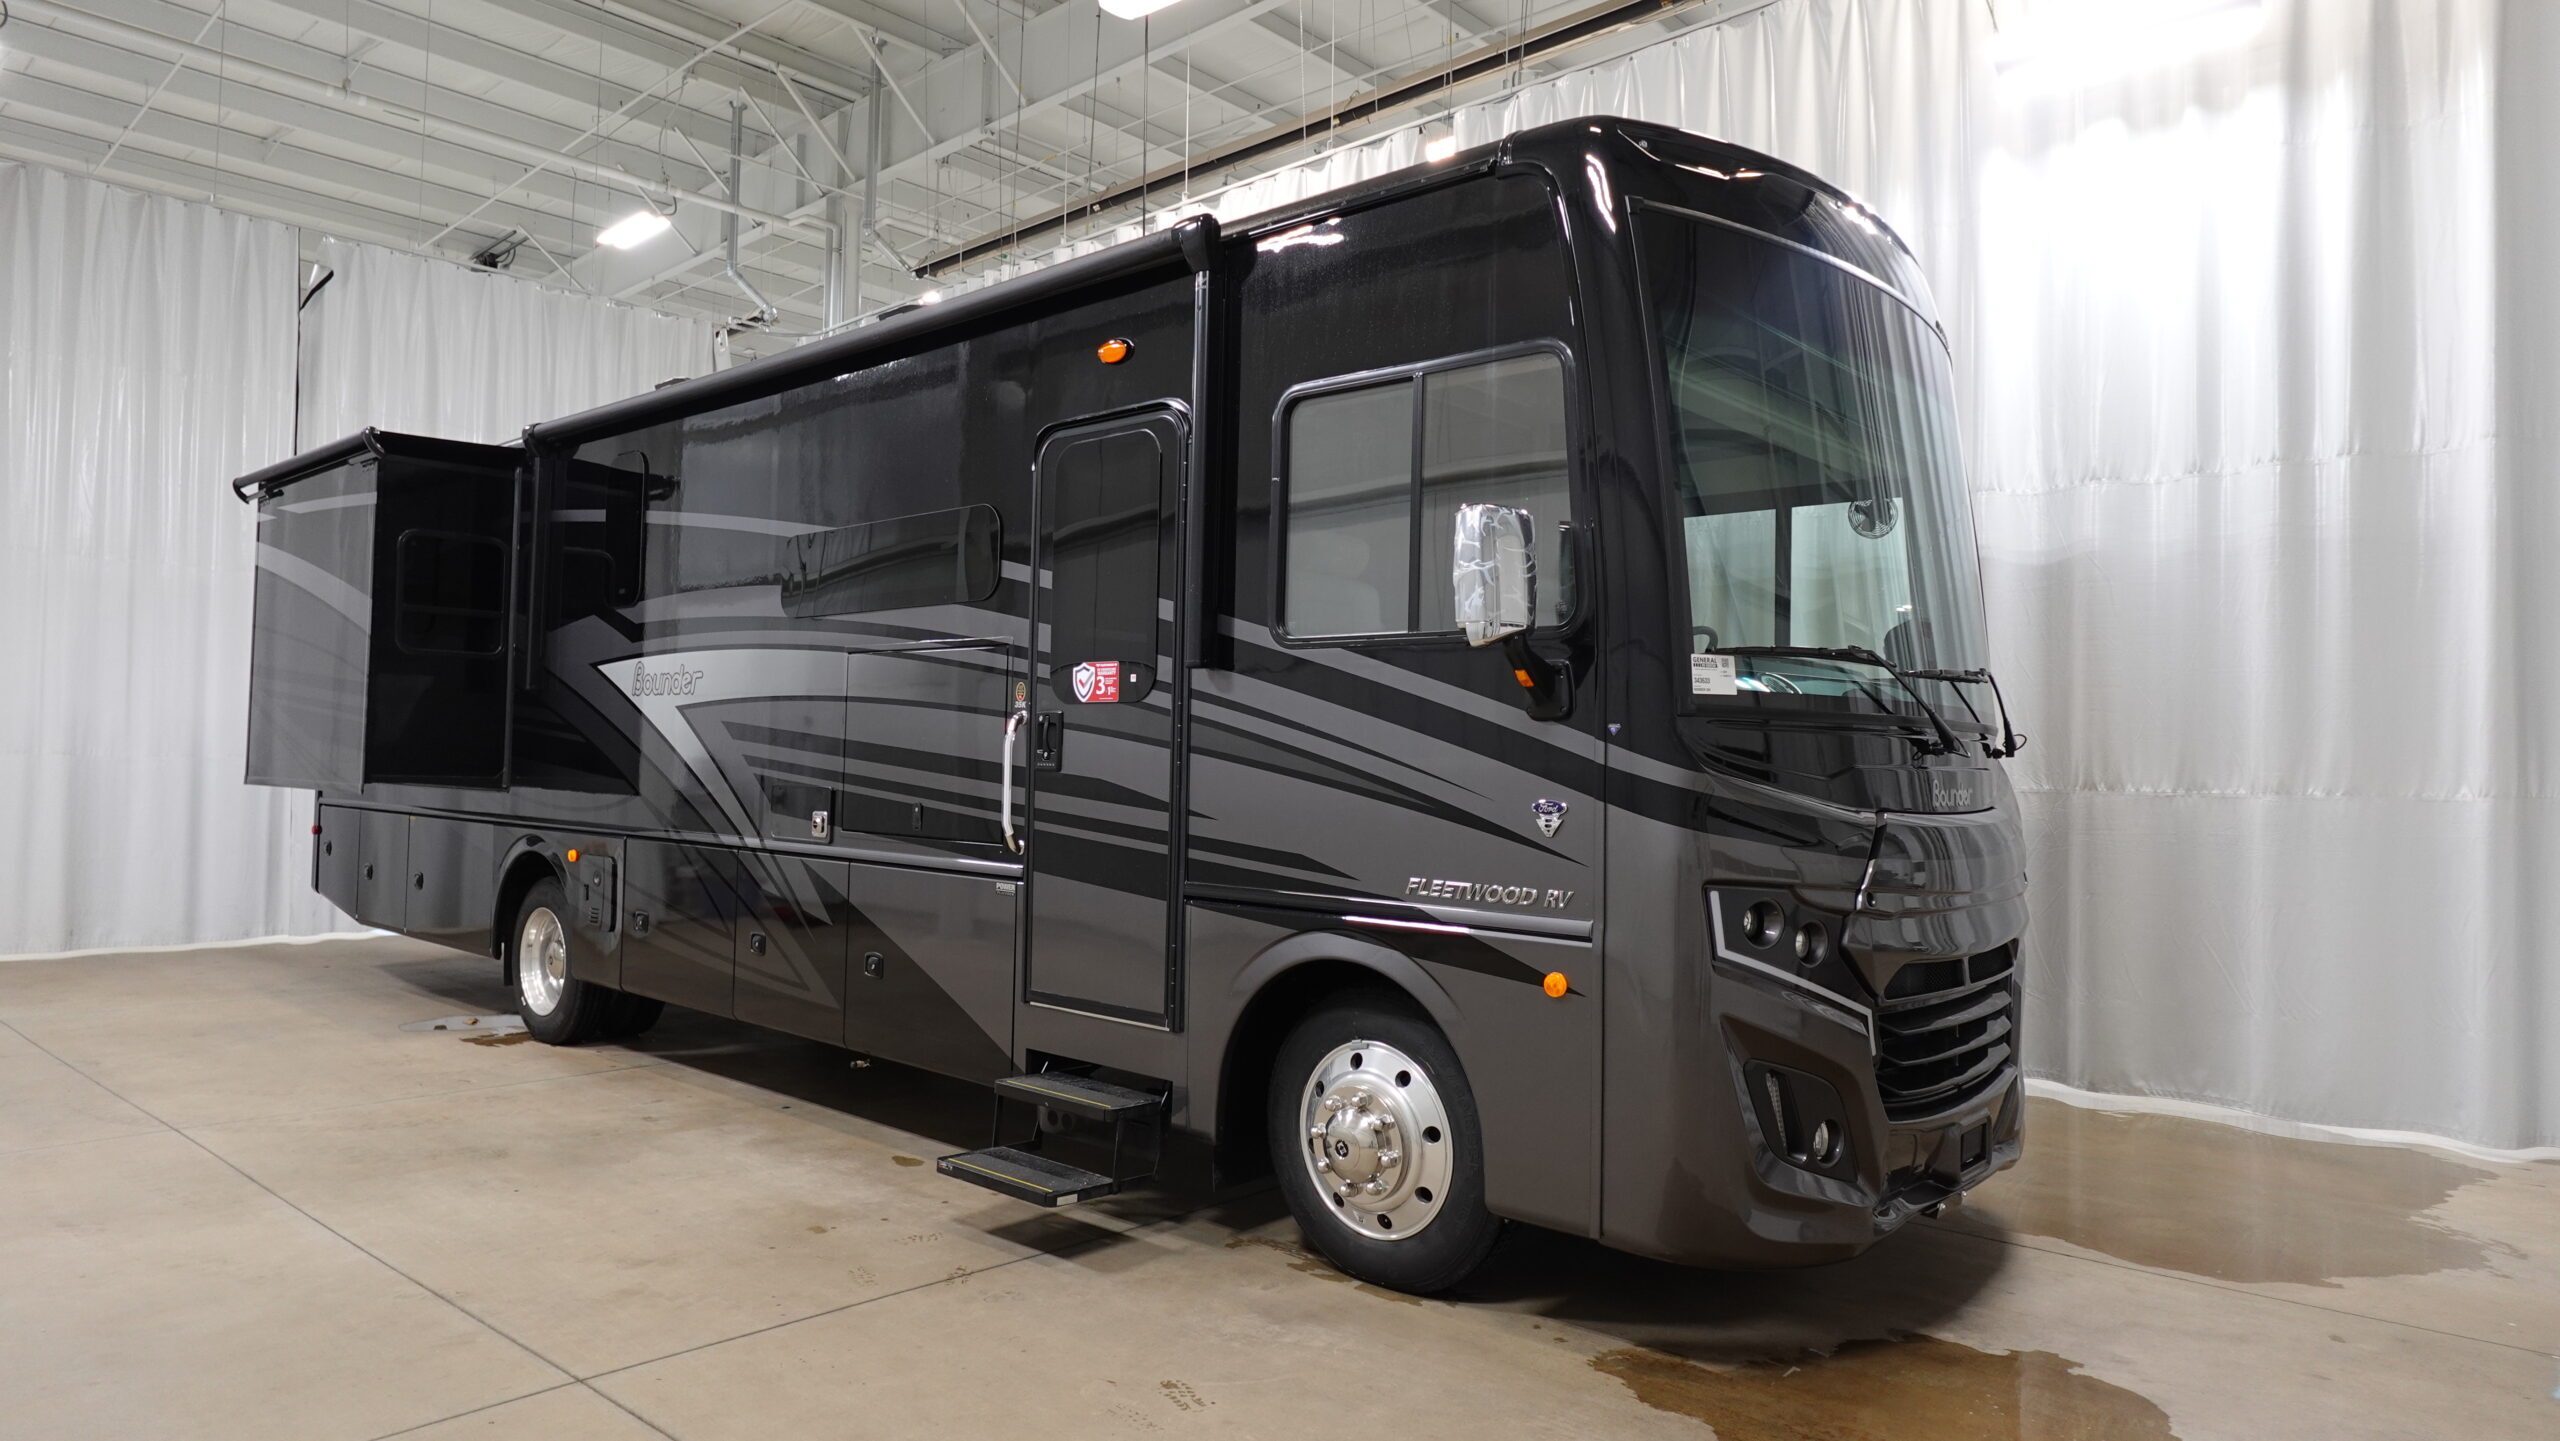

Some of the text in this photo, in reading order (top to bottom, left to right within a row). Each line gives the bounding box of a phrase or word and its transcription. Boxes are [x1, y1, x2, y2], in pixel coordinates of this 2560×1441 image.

[632, 661, 703, 696] Bounder
[1096, 676, 1105, 694] 3
[1932, 780, 1973, 807] Bounder
[1538, 802, 1559, 813] Ford
[1405, 877, 1574, 909] FLEETWOOD RV
